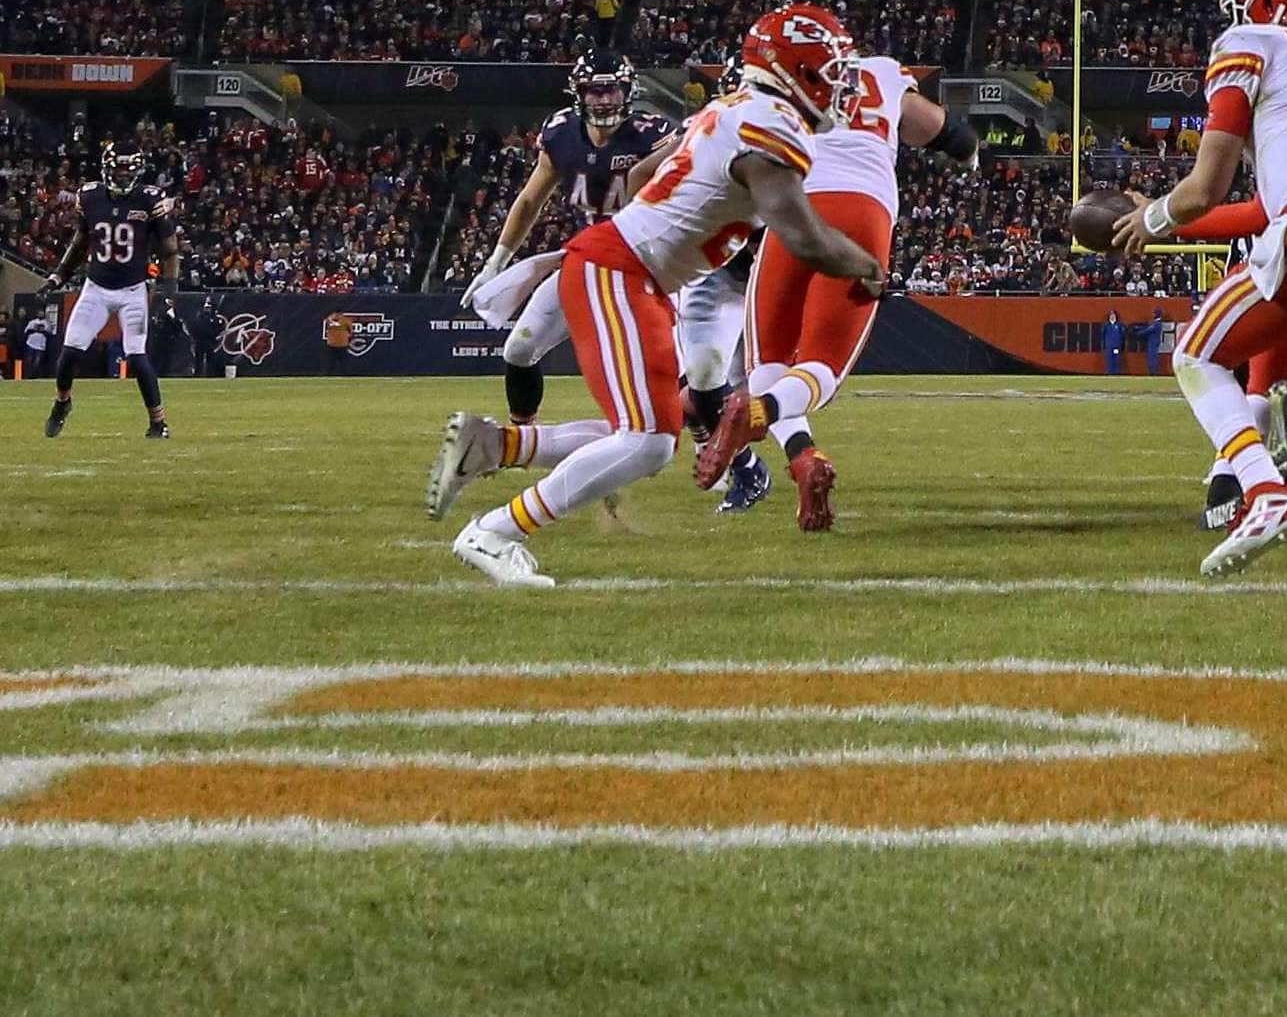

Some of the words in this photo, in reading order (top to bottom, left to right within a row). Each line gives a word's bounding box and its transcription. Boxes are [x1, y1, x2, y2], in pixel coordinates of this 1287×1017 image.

[218, 79, 239, 92] 120
[981, 87, 1001, 99] 122
[95, 222, 134, 263] 39
[1205, 498, 1239, 529] NIKE
